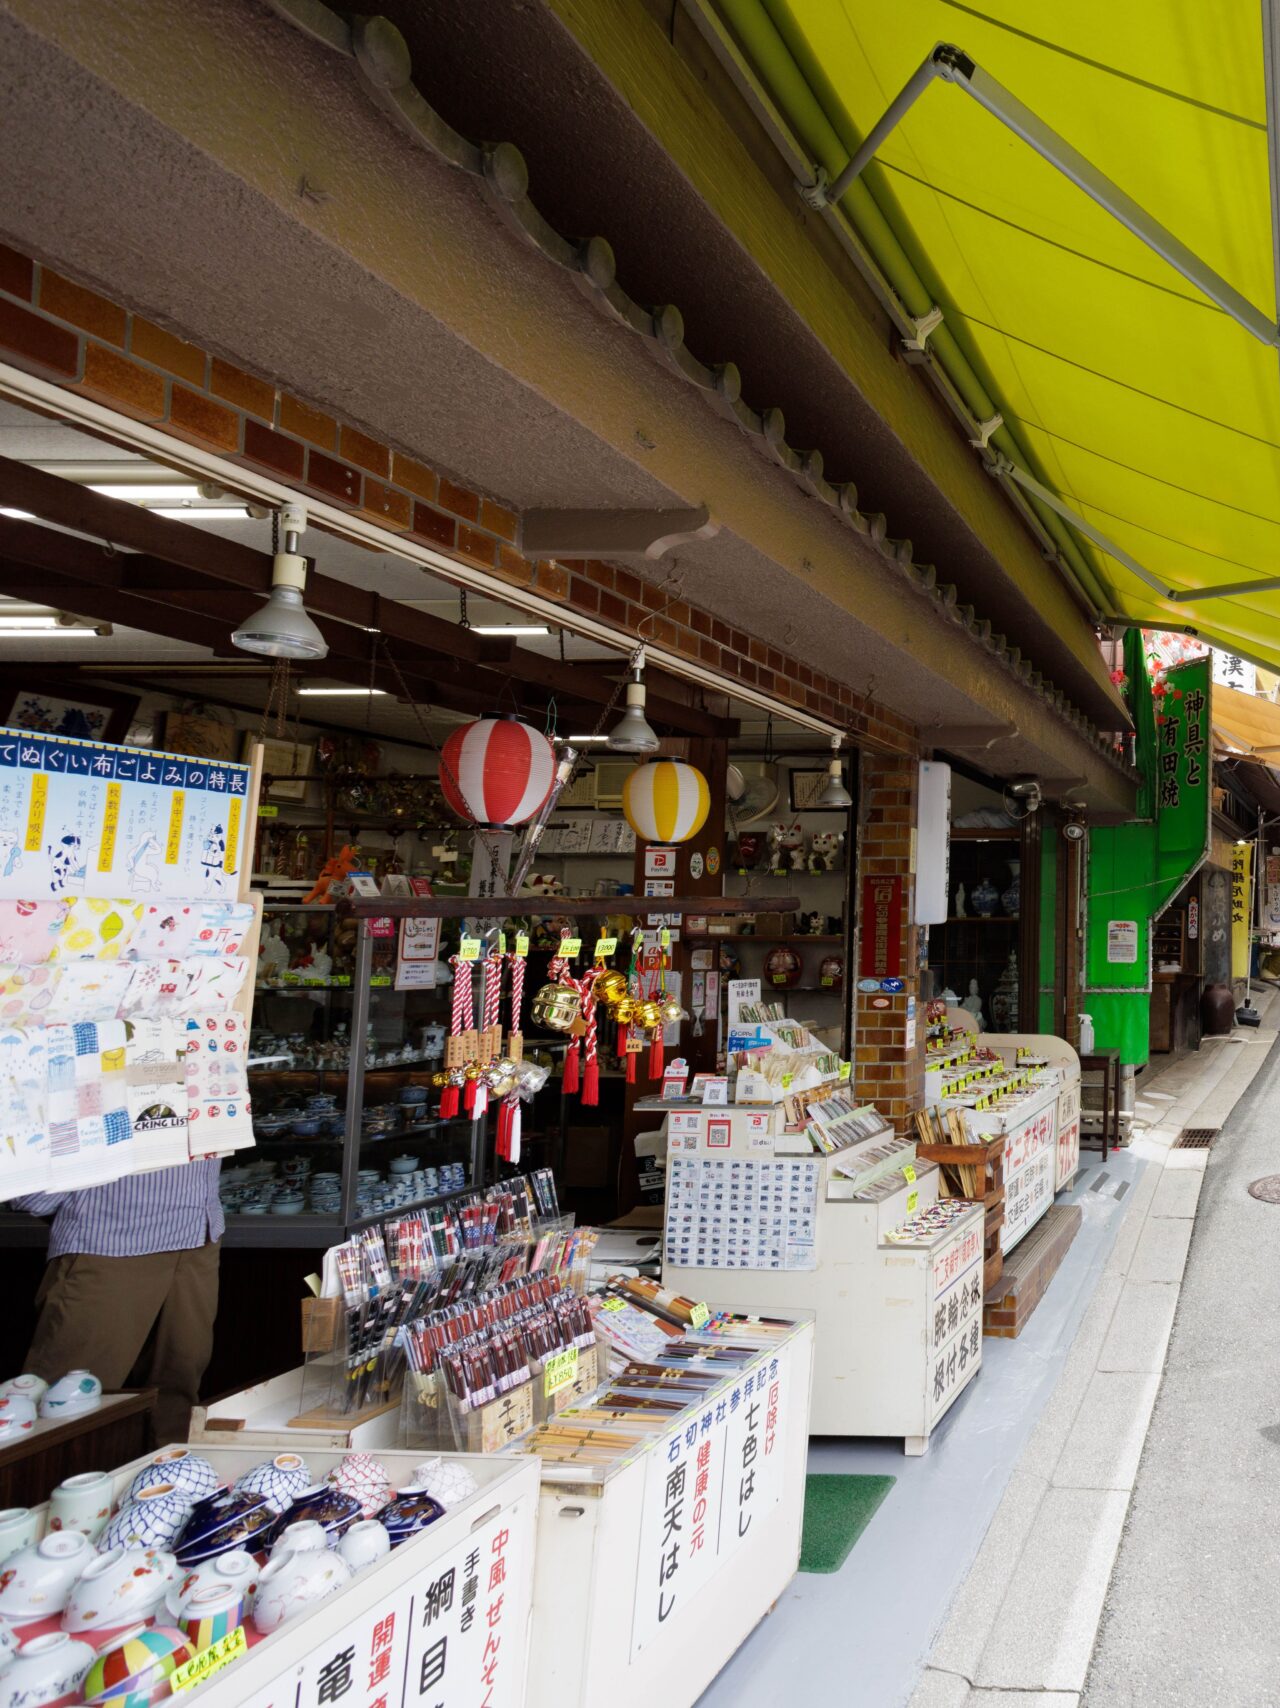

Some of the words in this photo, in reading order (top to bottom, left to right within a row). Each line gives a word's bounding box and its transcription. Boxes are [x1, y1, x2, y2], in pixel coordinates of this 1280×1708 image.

[0, 744, 245, 792] てぬぐい布ごよみの特長
[1161, 716, 1180, 808] 有田焼
[1184, 689, 1204, 786] 神具と
[28, 777, 46, 847] しっかり吸水
[101, 787, 120, 870] 枚数が増えても
[933, 1270, 982, 1348] 腕輪念珠
[933, 1319, 979, 1402] 根付各種
[667, 1358, 780, 1463] 石切神社参拝記念
[764, 1380, 780, 1456] 厄除け
[689, 1439, 711, 1558] 健康の元
[738, 1402, 760, 1537] 七色はし
[658, 1460, 687, 1622] 南天はし
[460, 1547, 480, 1633] 手書き
